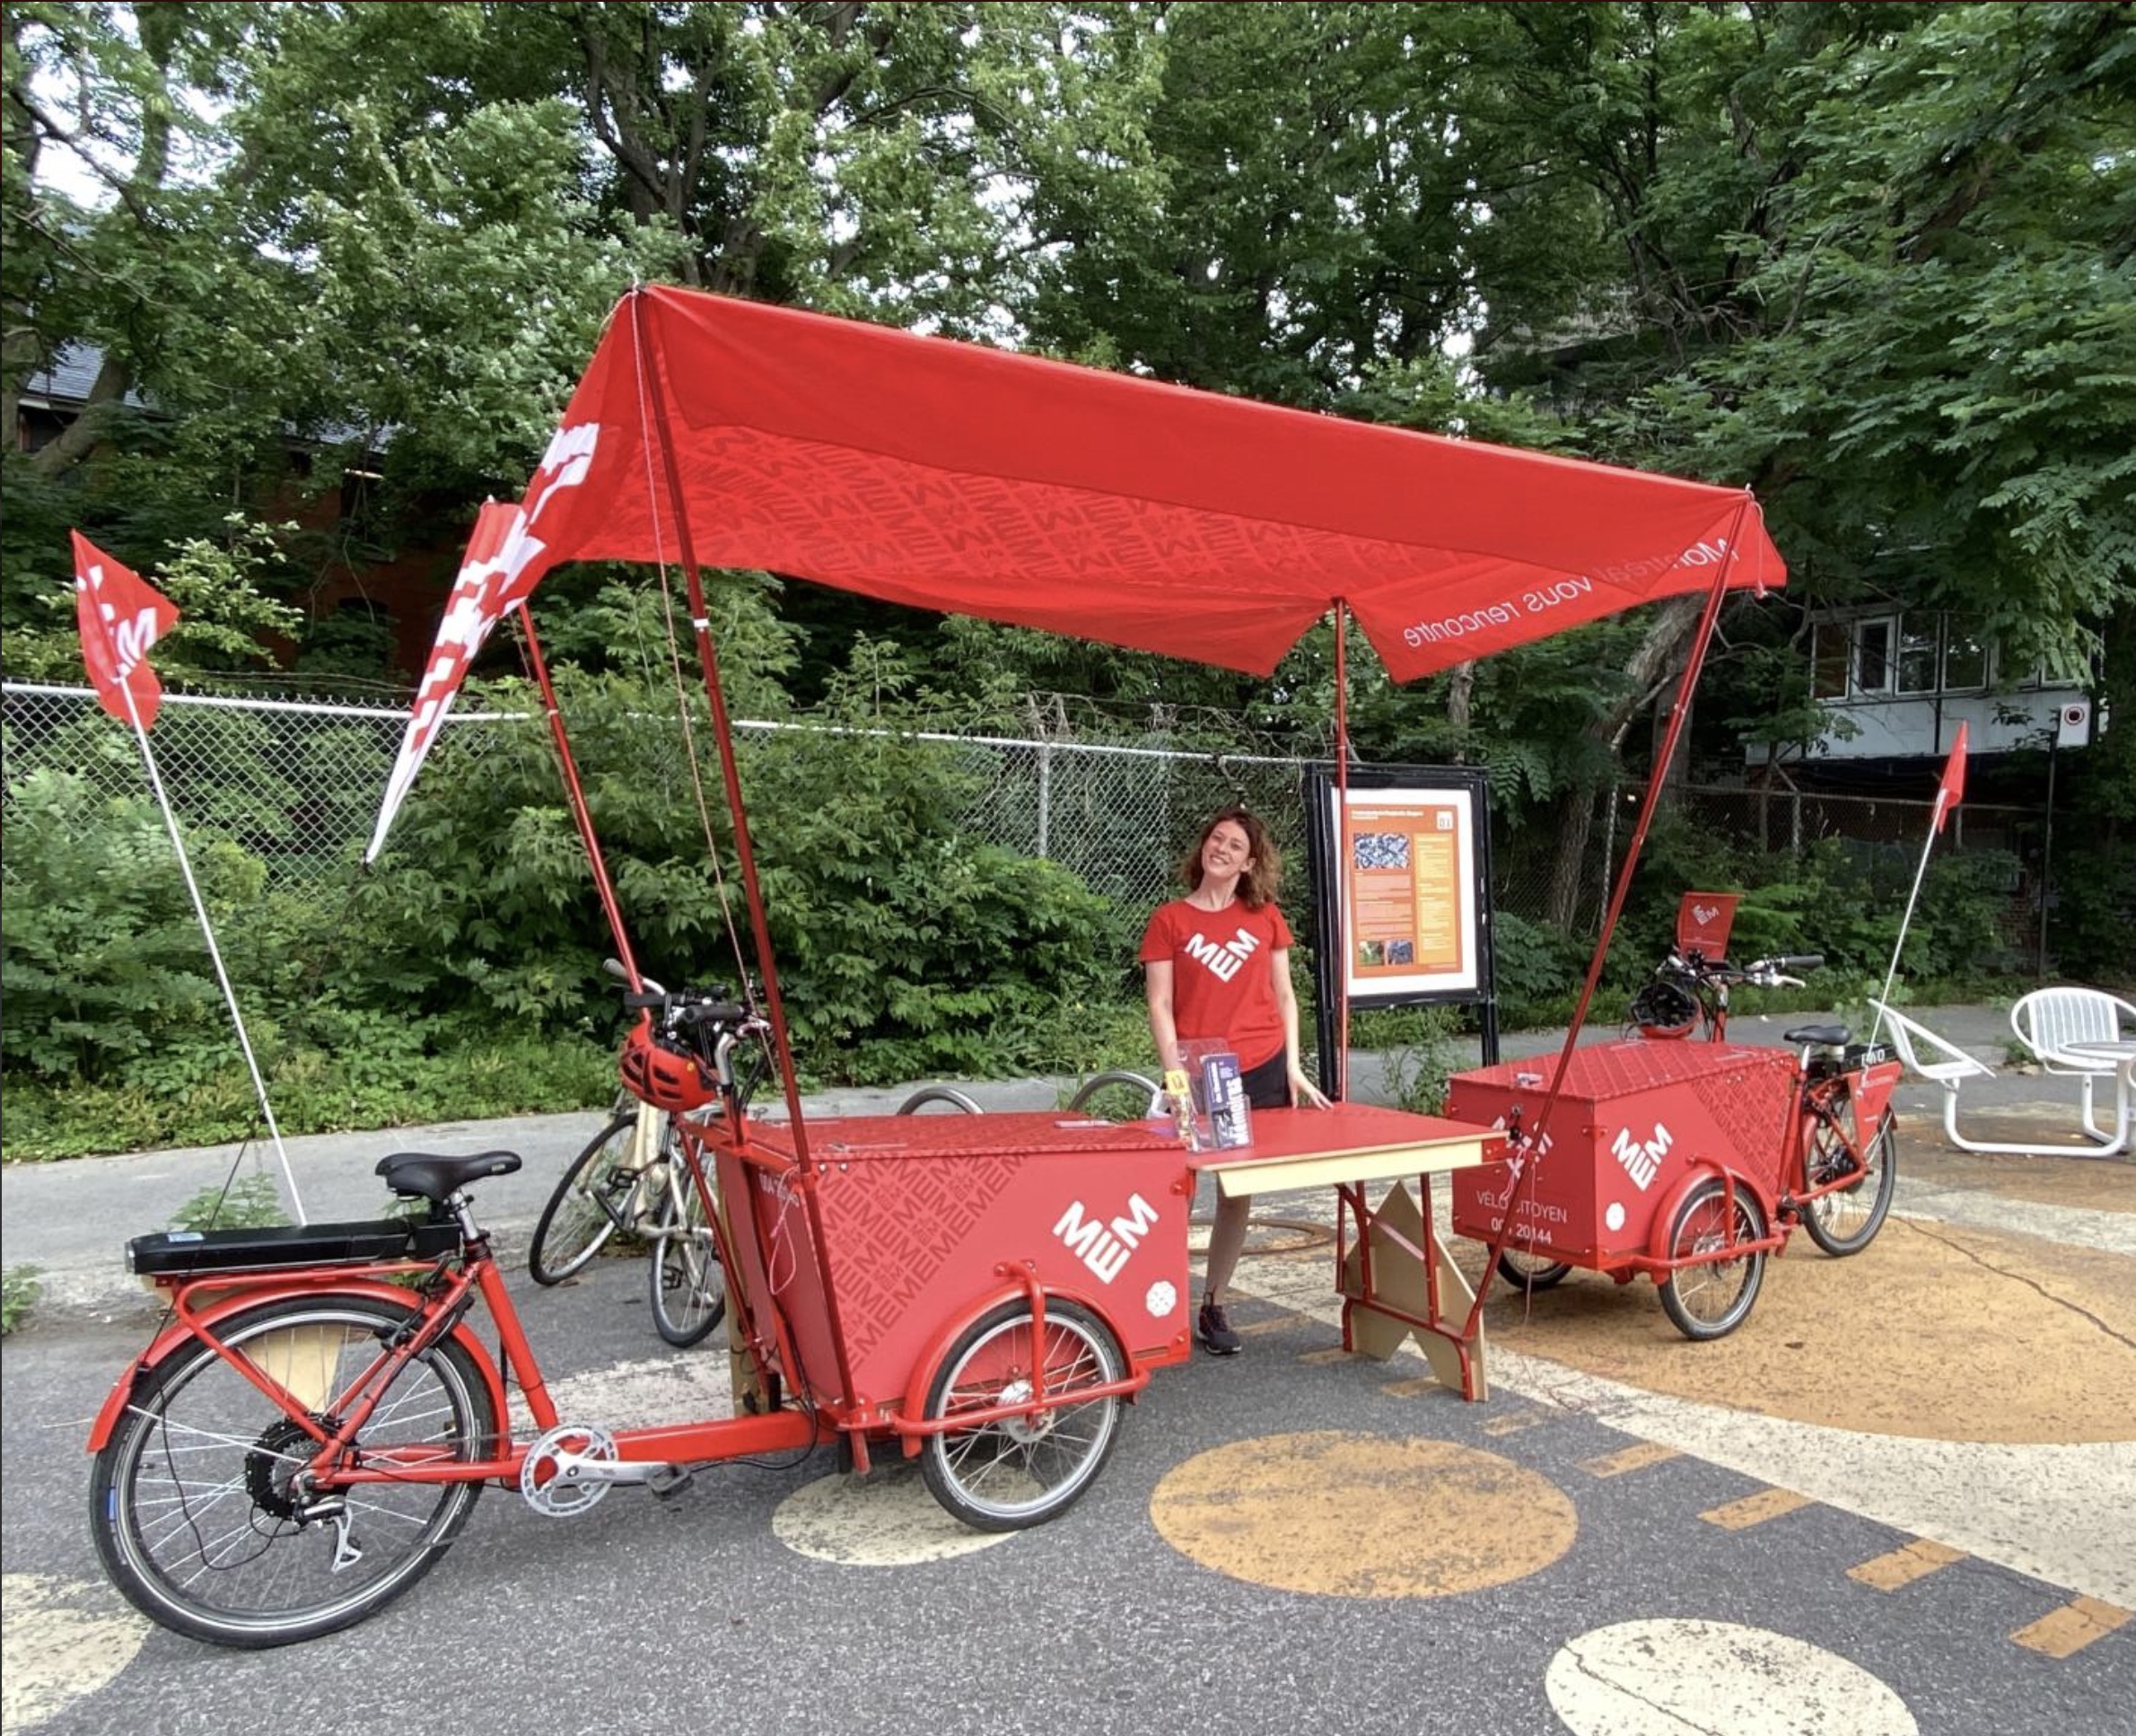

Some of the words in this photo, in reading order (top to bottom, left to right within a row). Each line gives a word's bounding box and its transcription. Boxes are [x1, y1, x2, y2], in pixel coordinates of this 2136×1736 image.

[1185, 928, 1260, 983] MEM
[1611, 1122, 1673, 1191] MEM
[1053, 1193, 1160, 1284] MEM
[1515, 1199, 1568, 1223] ITOYEN
[1516, 1223, 1552, 1245] 20144
